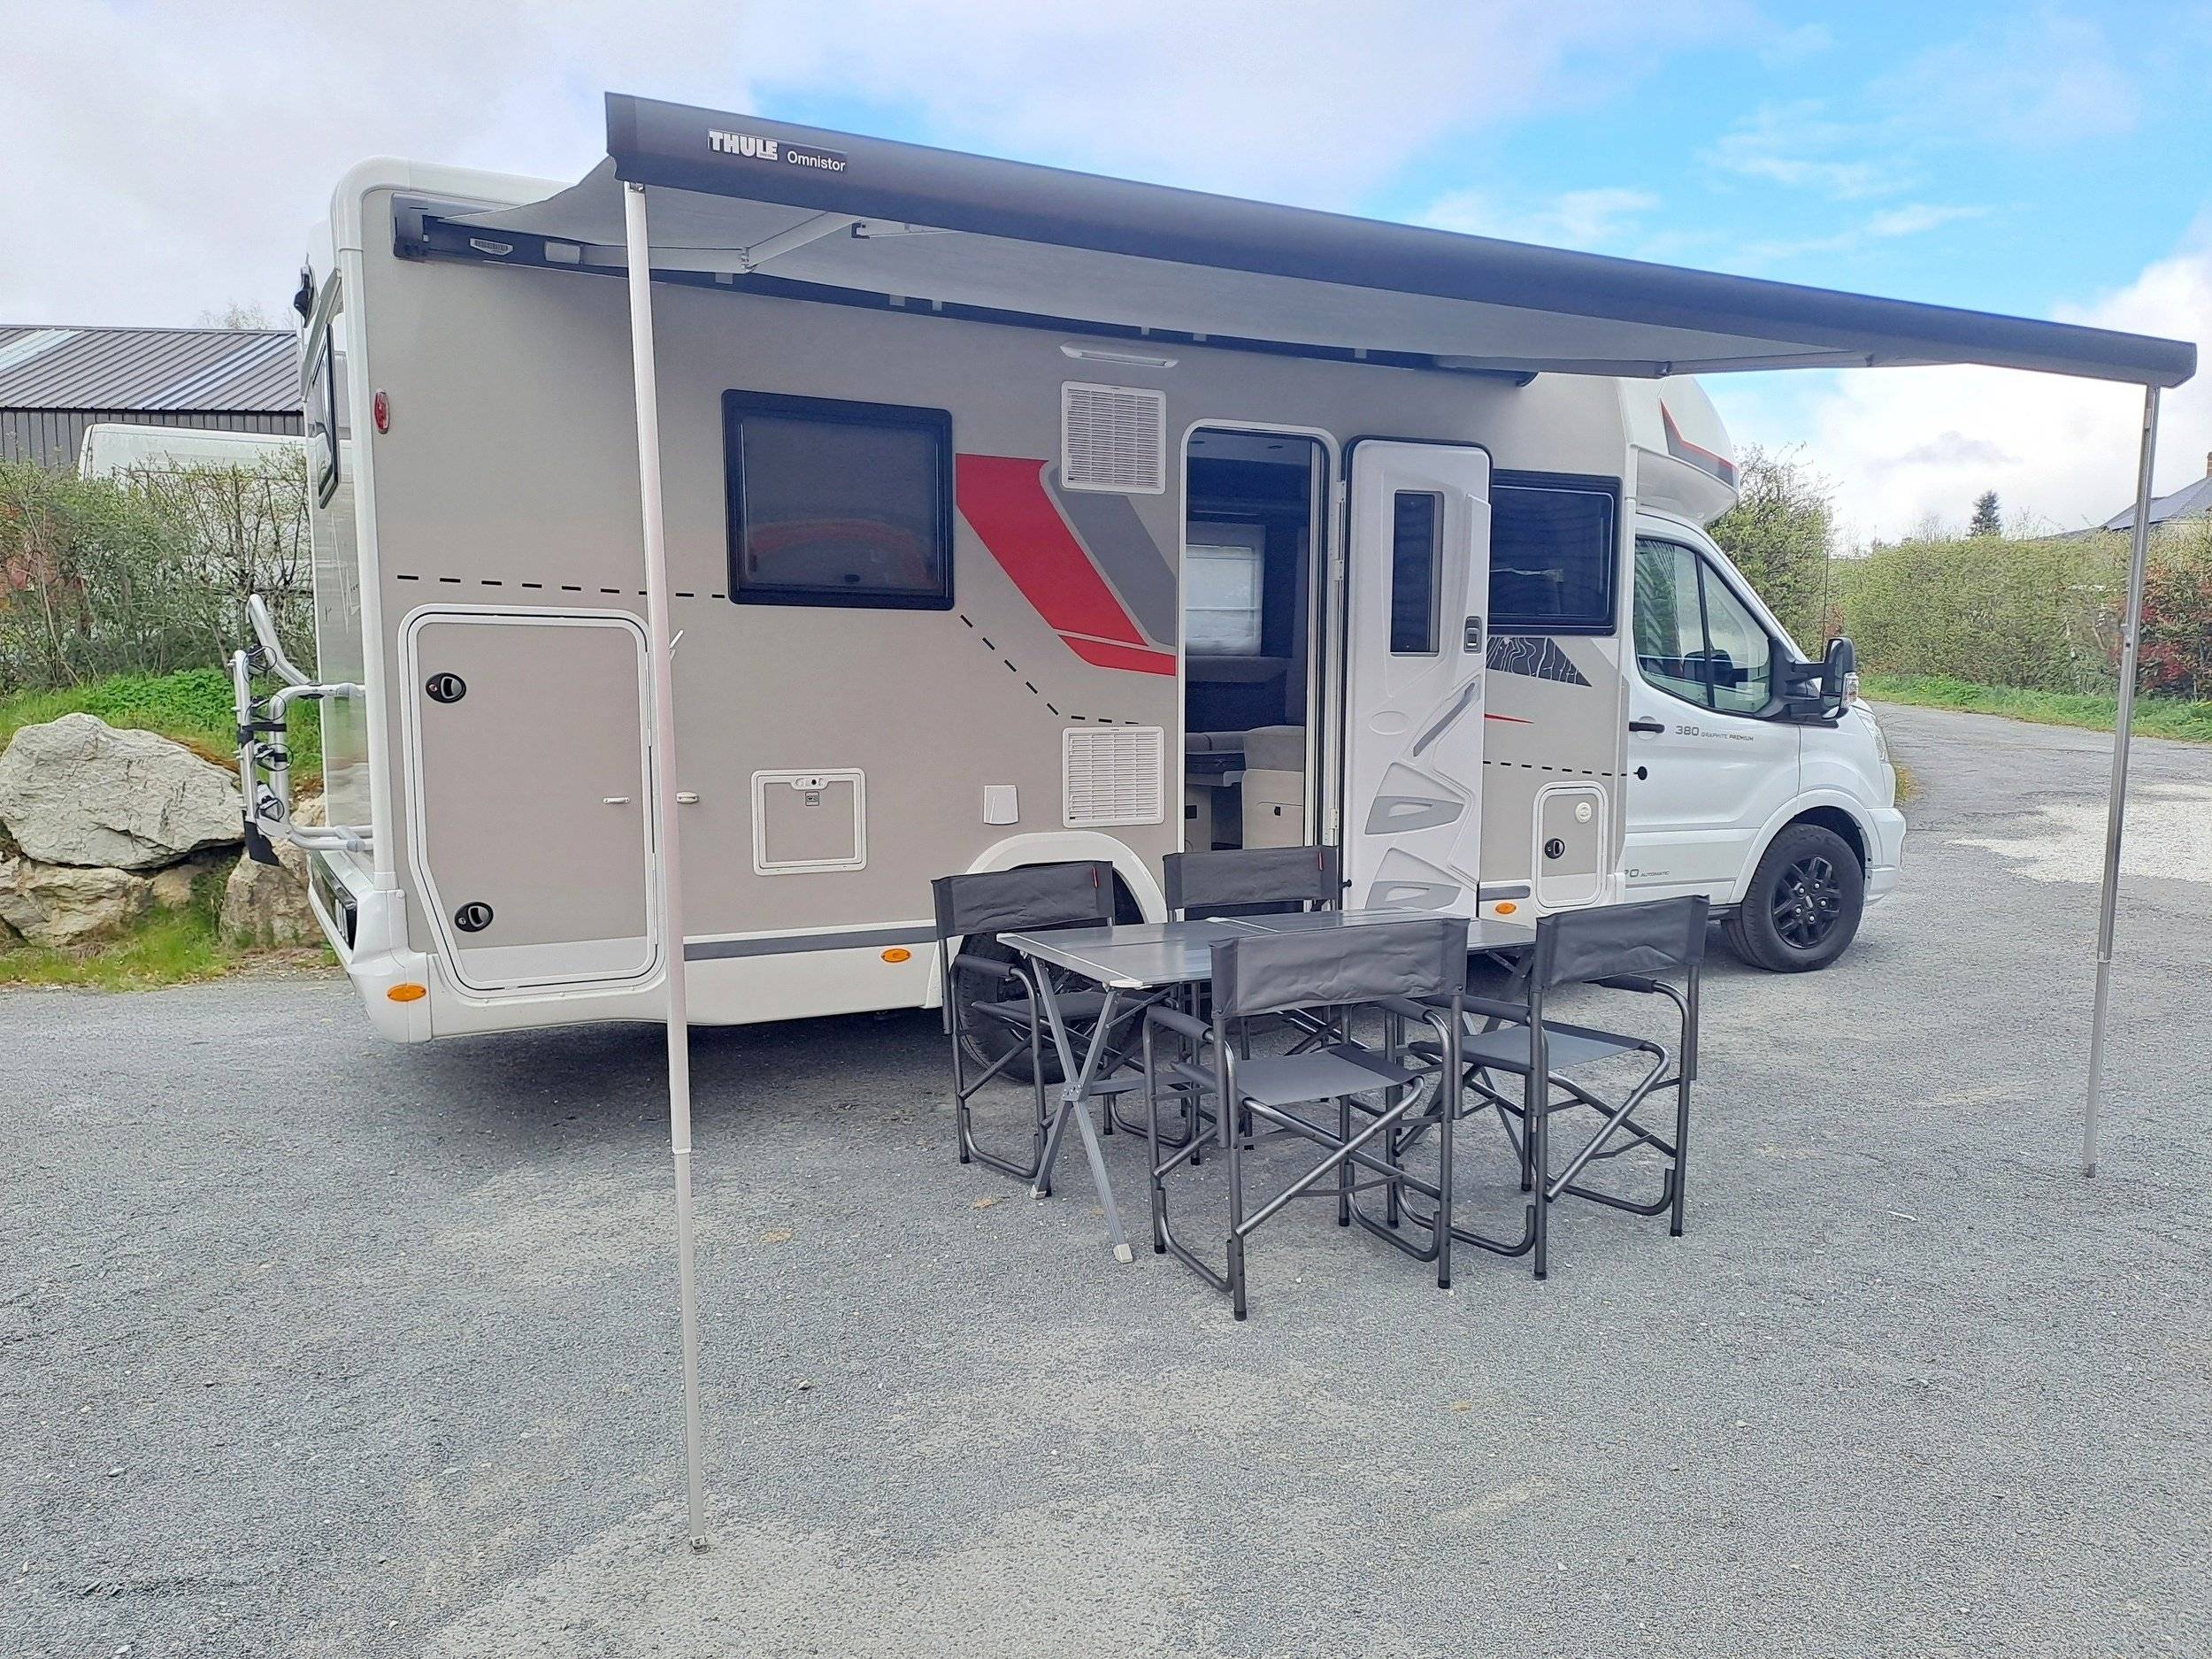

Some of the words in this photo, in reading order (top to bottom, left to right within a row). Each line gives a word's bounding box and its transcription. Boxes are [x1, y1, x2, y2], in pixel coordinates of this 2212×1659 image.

[709, 130, 778, 161] THULE
[787, 150, 846, 173] Omnistor
[1675, 725, 1700, 736] 380
